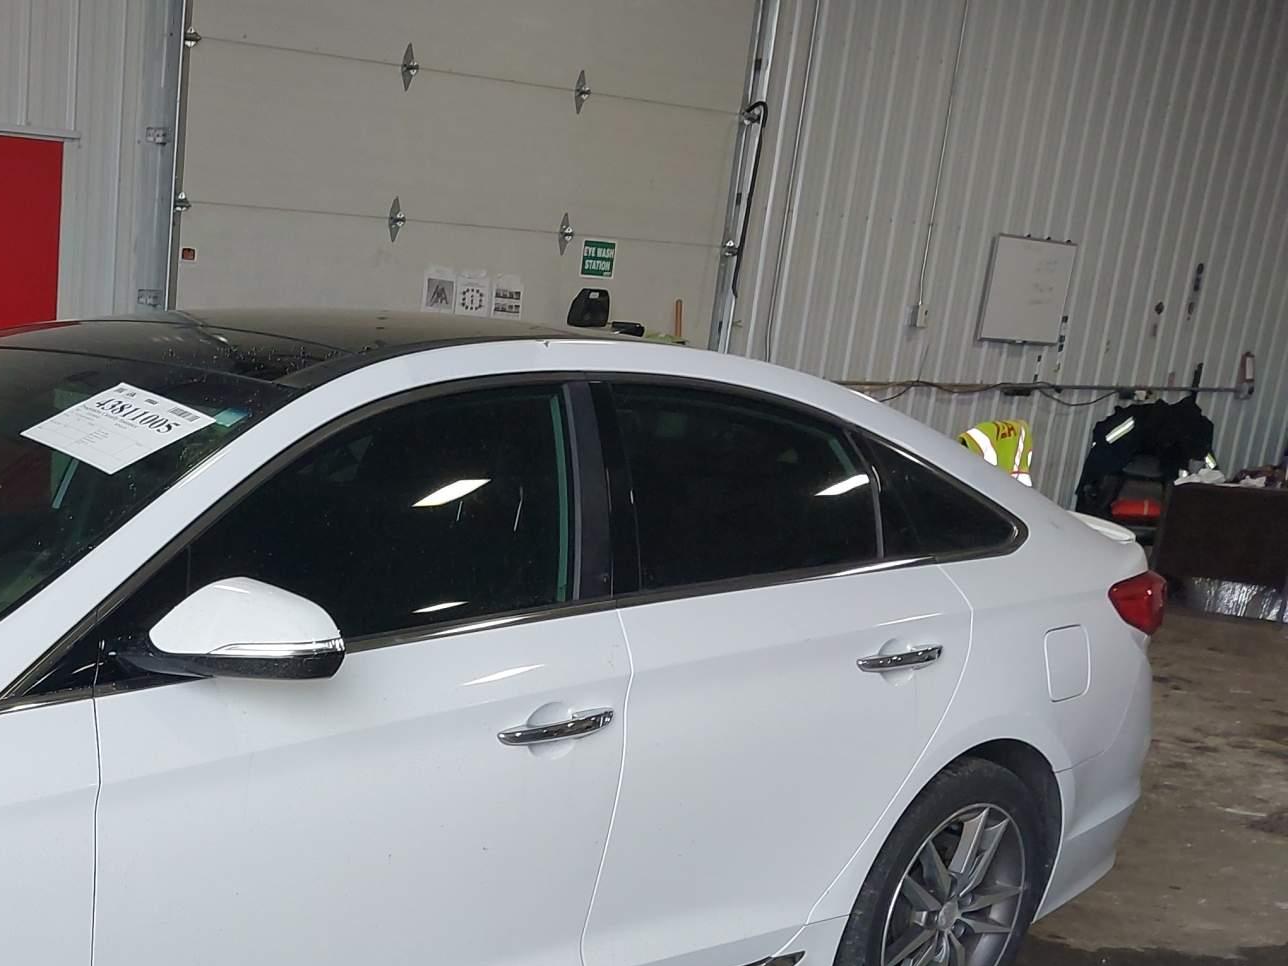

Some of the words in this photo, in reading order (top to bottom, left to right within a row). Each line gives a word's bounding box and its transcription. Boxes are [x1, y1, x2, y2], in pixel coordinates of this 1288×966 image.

[584, 246, 596, 256] EYE
[597, 247, 614, 258] WASH
[584, 259, 611, 271] STATION
[95, 398, 181, 434] 43811005
